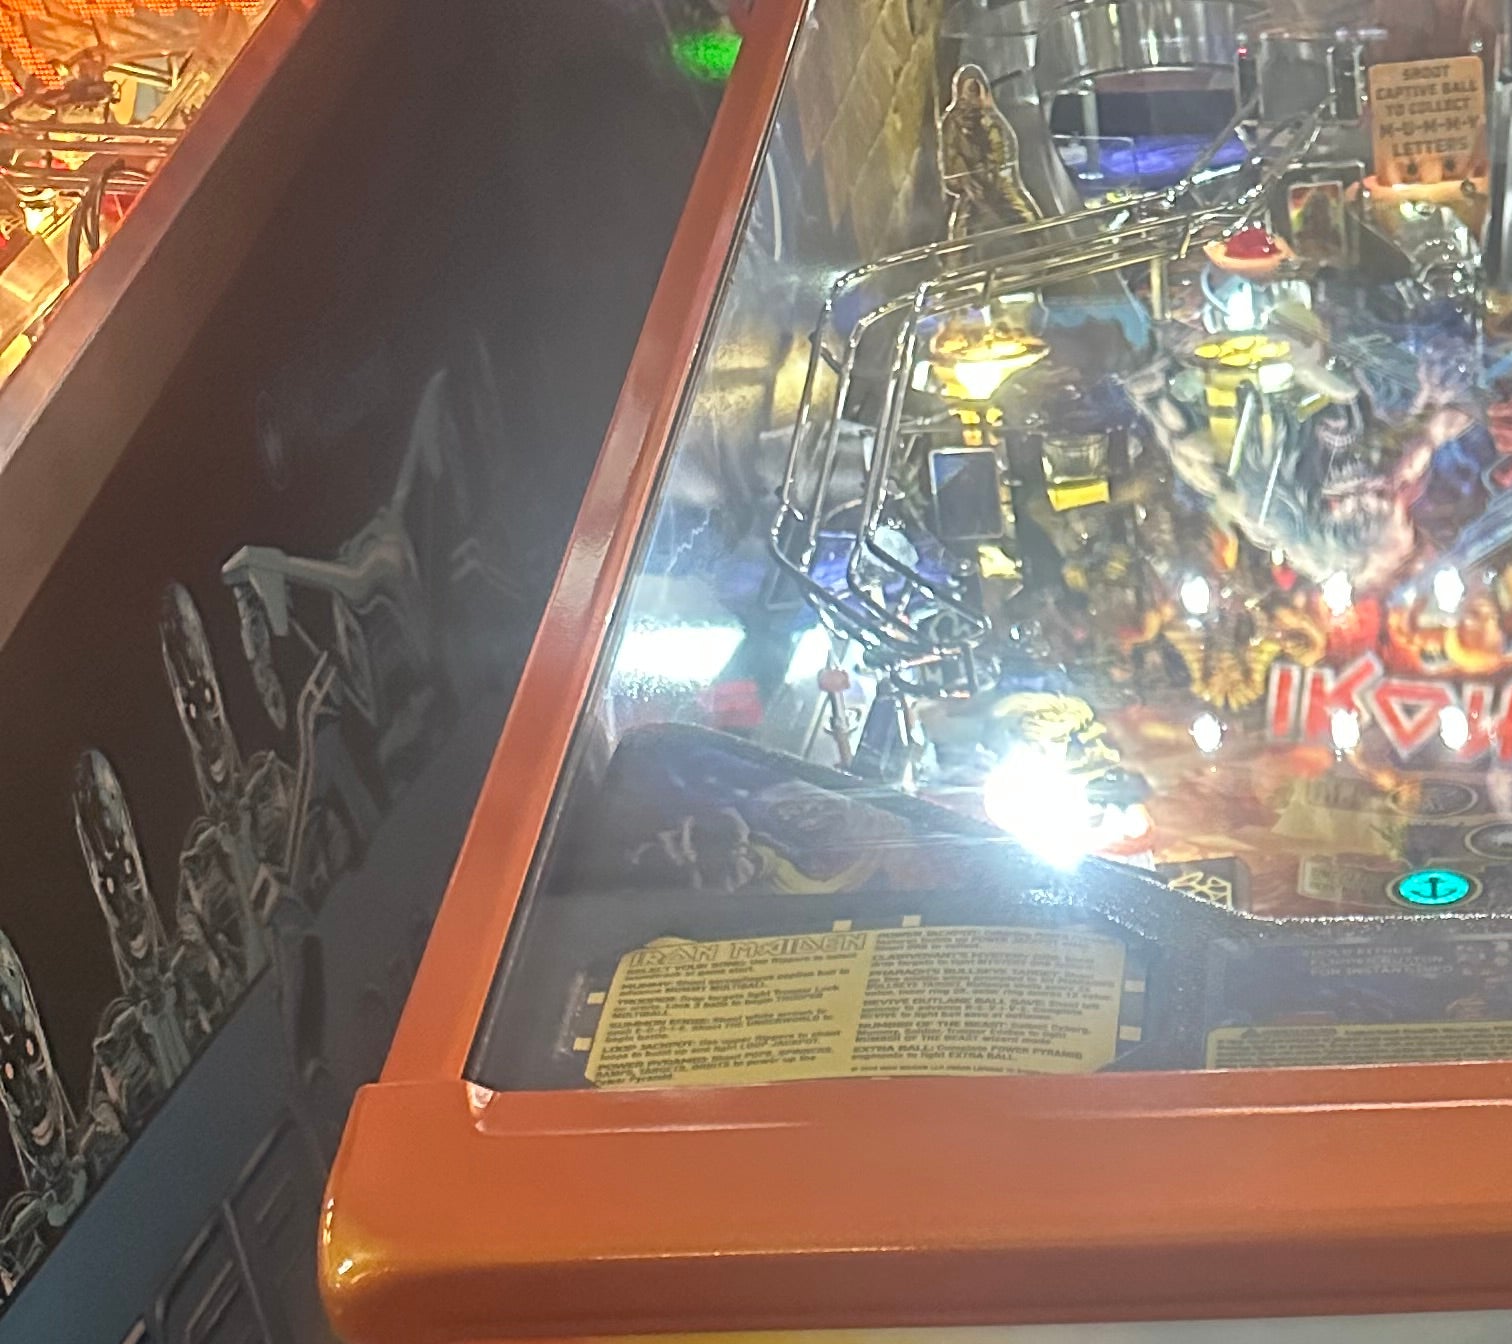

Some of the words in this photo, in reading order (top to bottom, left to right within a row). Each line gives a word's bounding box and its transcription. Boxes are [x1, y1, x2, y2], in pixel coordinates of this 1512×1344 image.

[1375, 84, 1437, 100] CAPTIVE
[1441, 80, 1478, 94] BALL
[1385, 103, 1405, 116] TO
[1408, 98, 1470, 114] COLLECT
[1391, 136, 1468, 157] LETTERS
[729, 934, 867, 959] MAIDEN
